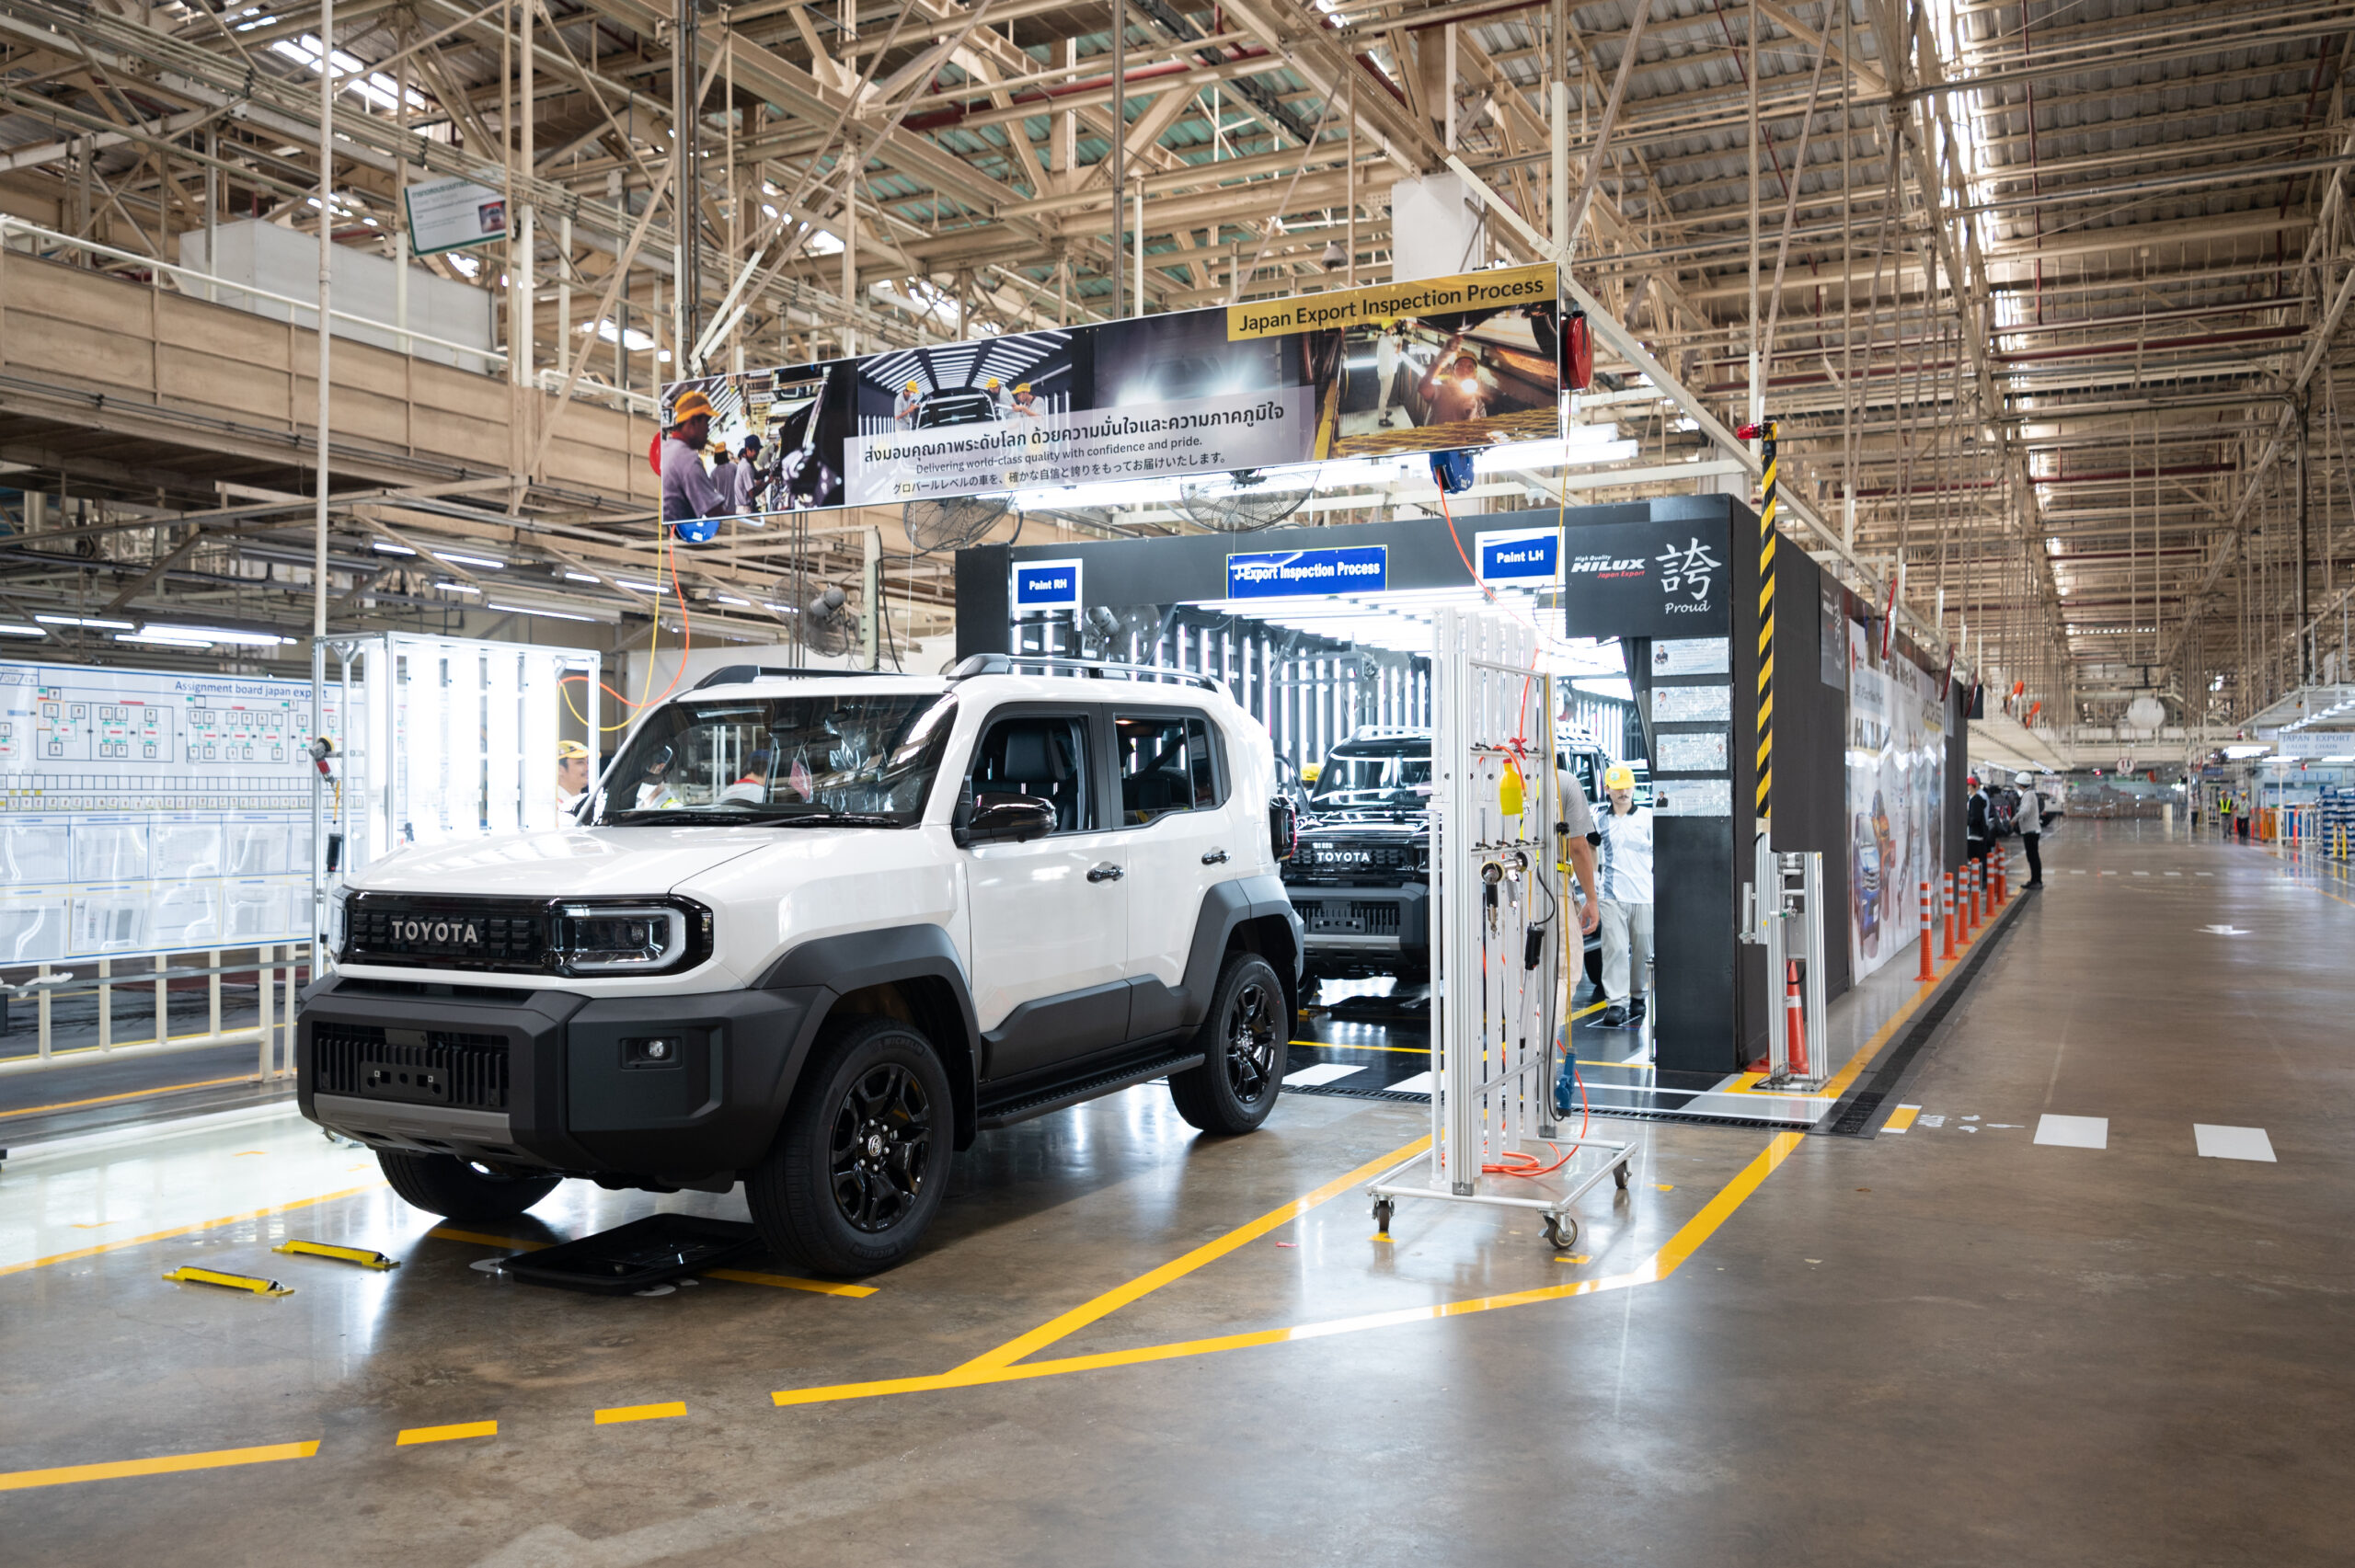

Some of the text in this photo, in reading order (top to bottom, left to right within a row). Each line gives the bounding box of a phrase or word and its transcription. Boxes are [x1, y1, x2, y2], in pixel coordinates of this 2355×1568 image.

[1239, 280, 1545, 334] Japan Export Inspection Process
[865, 430, 1027, 463] ส่งมอบคุณภาพระดับโลก
[916, 436, 1202, 475] Delivering world-class quality with confidence and pride.
[1496, 549, 1545, 564] Paint LH
[1234, 561, 1380, 583] J-Export Inspection Process
[1570, 558, 1646, 573] HILUX
[1655, 537, 1722, 601] 誇
[1597, 569, 1646, 579] Japan Export
[1028, 578, 1067, 590] Paint RH
[1664, 600, 1711, 614] Proud
[175, 681, 327, 699] Assignment board japan expt
[2282, 735, 2310, 743] JAPAN
[1316, 852, 1370, 862] TOYOTA
[392, 921, 477, 943] TOYOTA
